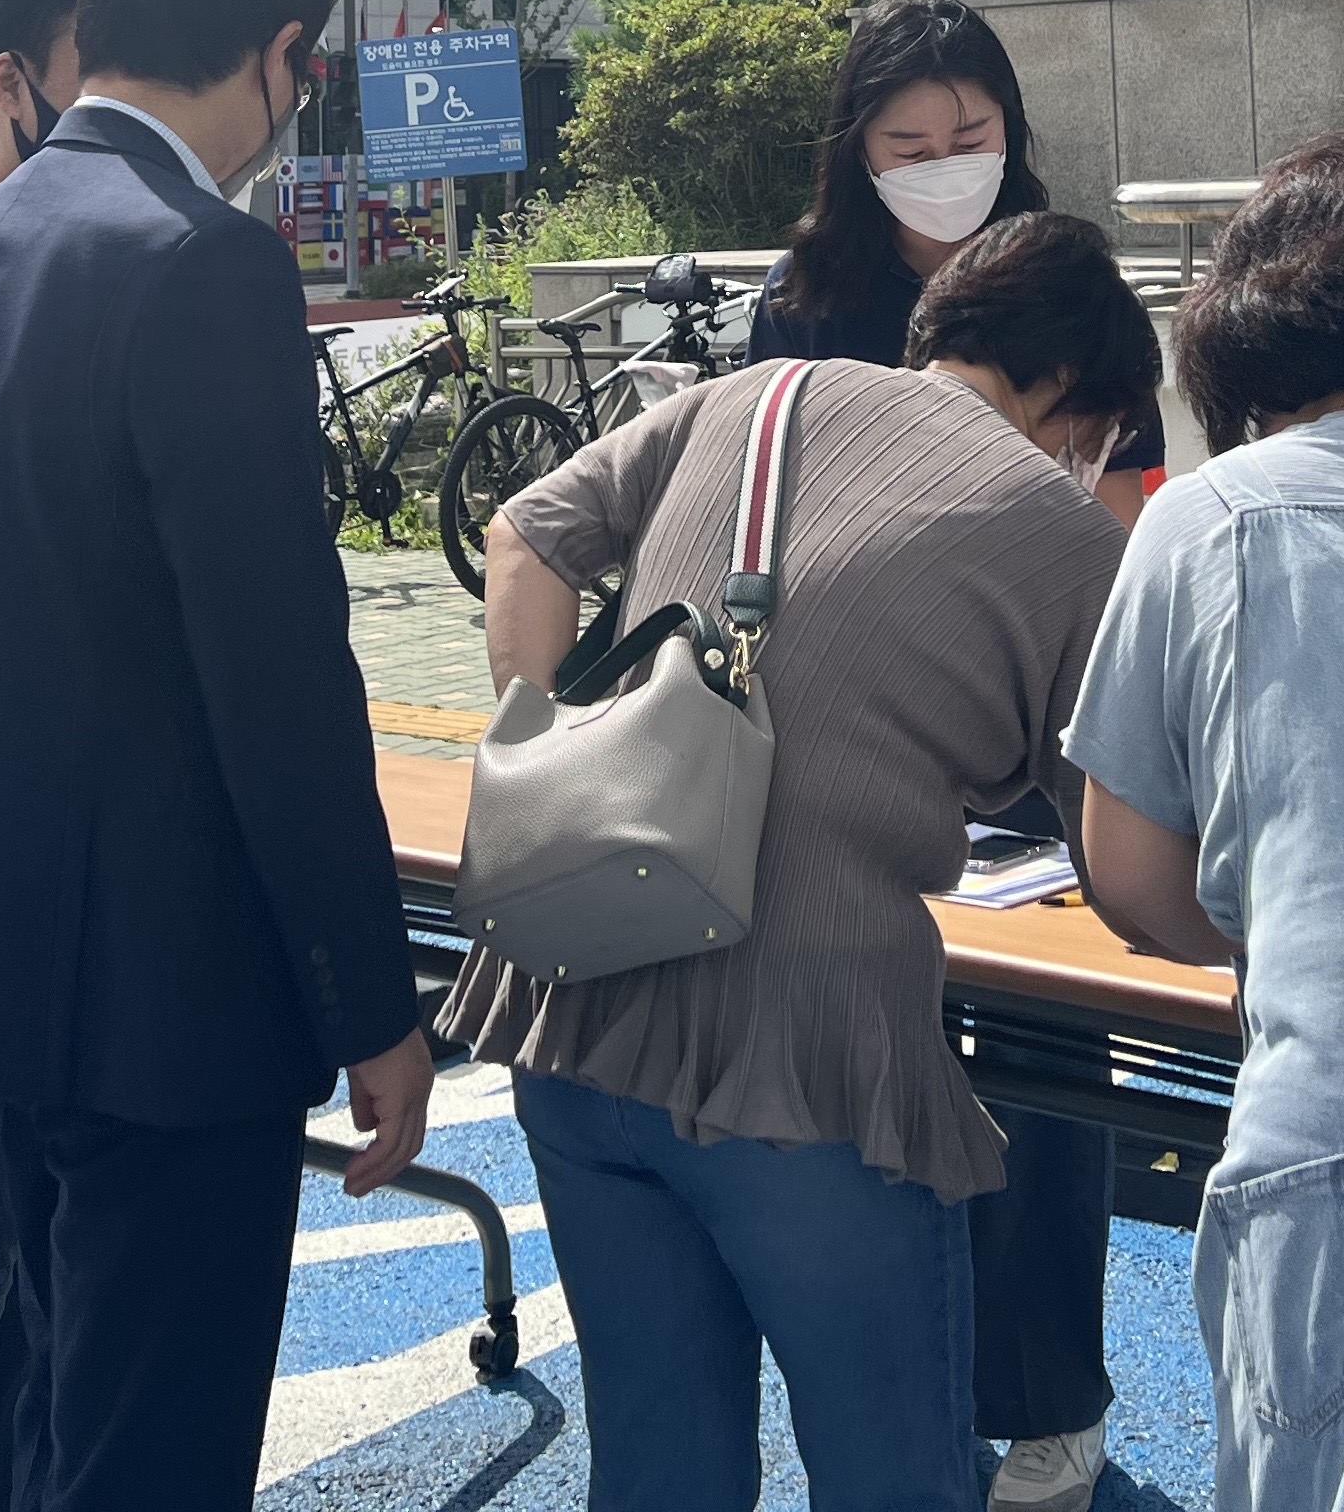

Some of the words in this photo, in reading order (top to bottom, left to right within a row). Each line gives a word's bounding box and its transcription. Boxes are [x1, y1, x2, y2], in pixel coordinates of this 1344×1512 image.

[363, 43, 407, 62] 장애인
[414, 39, 443, 57] 전용
[449, 33, 510, 53] 주차구역
[404, 73, 439, 126] P
